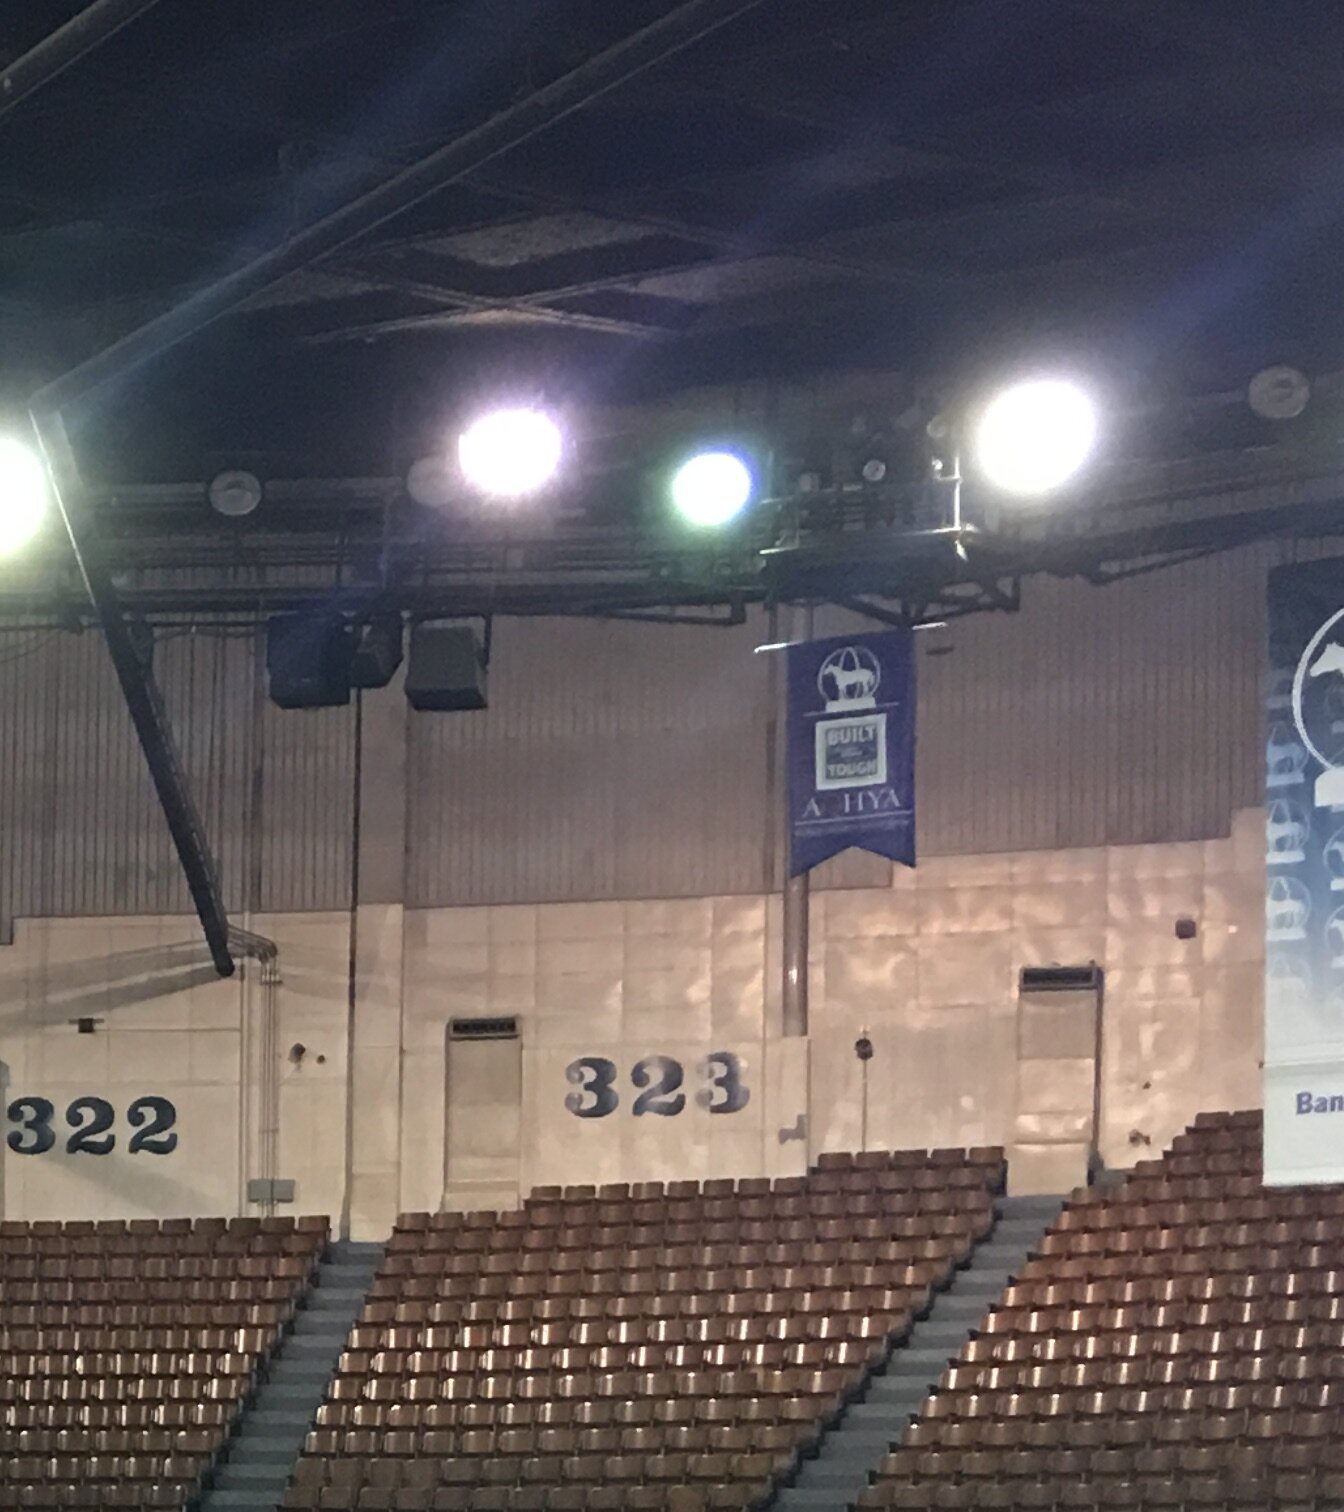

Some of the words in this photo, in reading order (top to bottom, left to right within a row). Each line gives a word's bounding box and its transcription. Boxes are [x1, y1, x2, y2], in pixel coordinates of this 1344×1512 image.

[827, 725, 877, 746] BUILT
[564, 1051, 750, 1118] 323
[6, 1096, 178, 1155] 322
